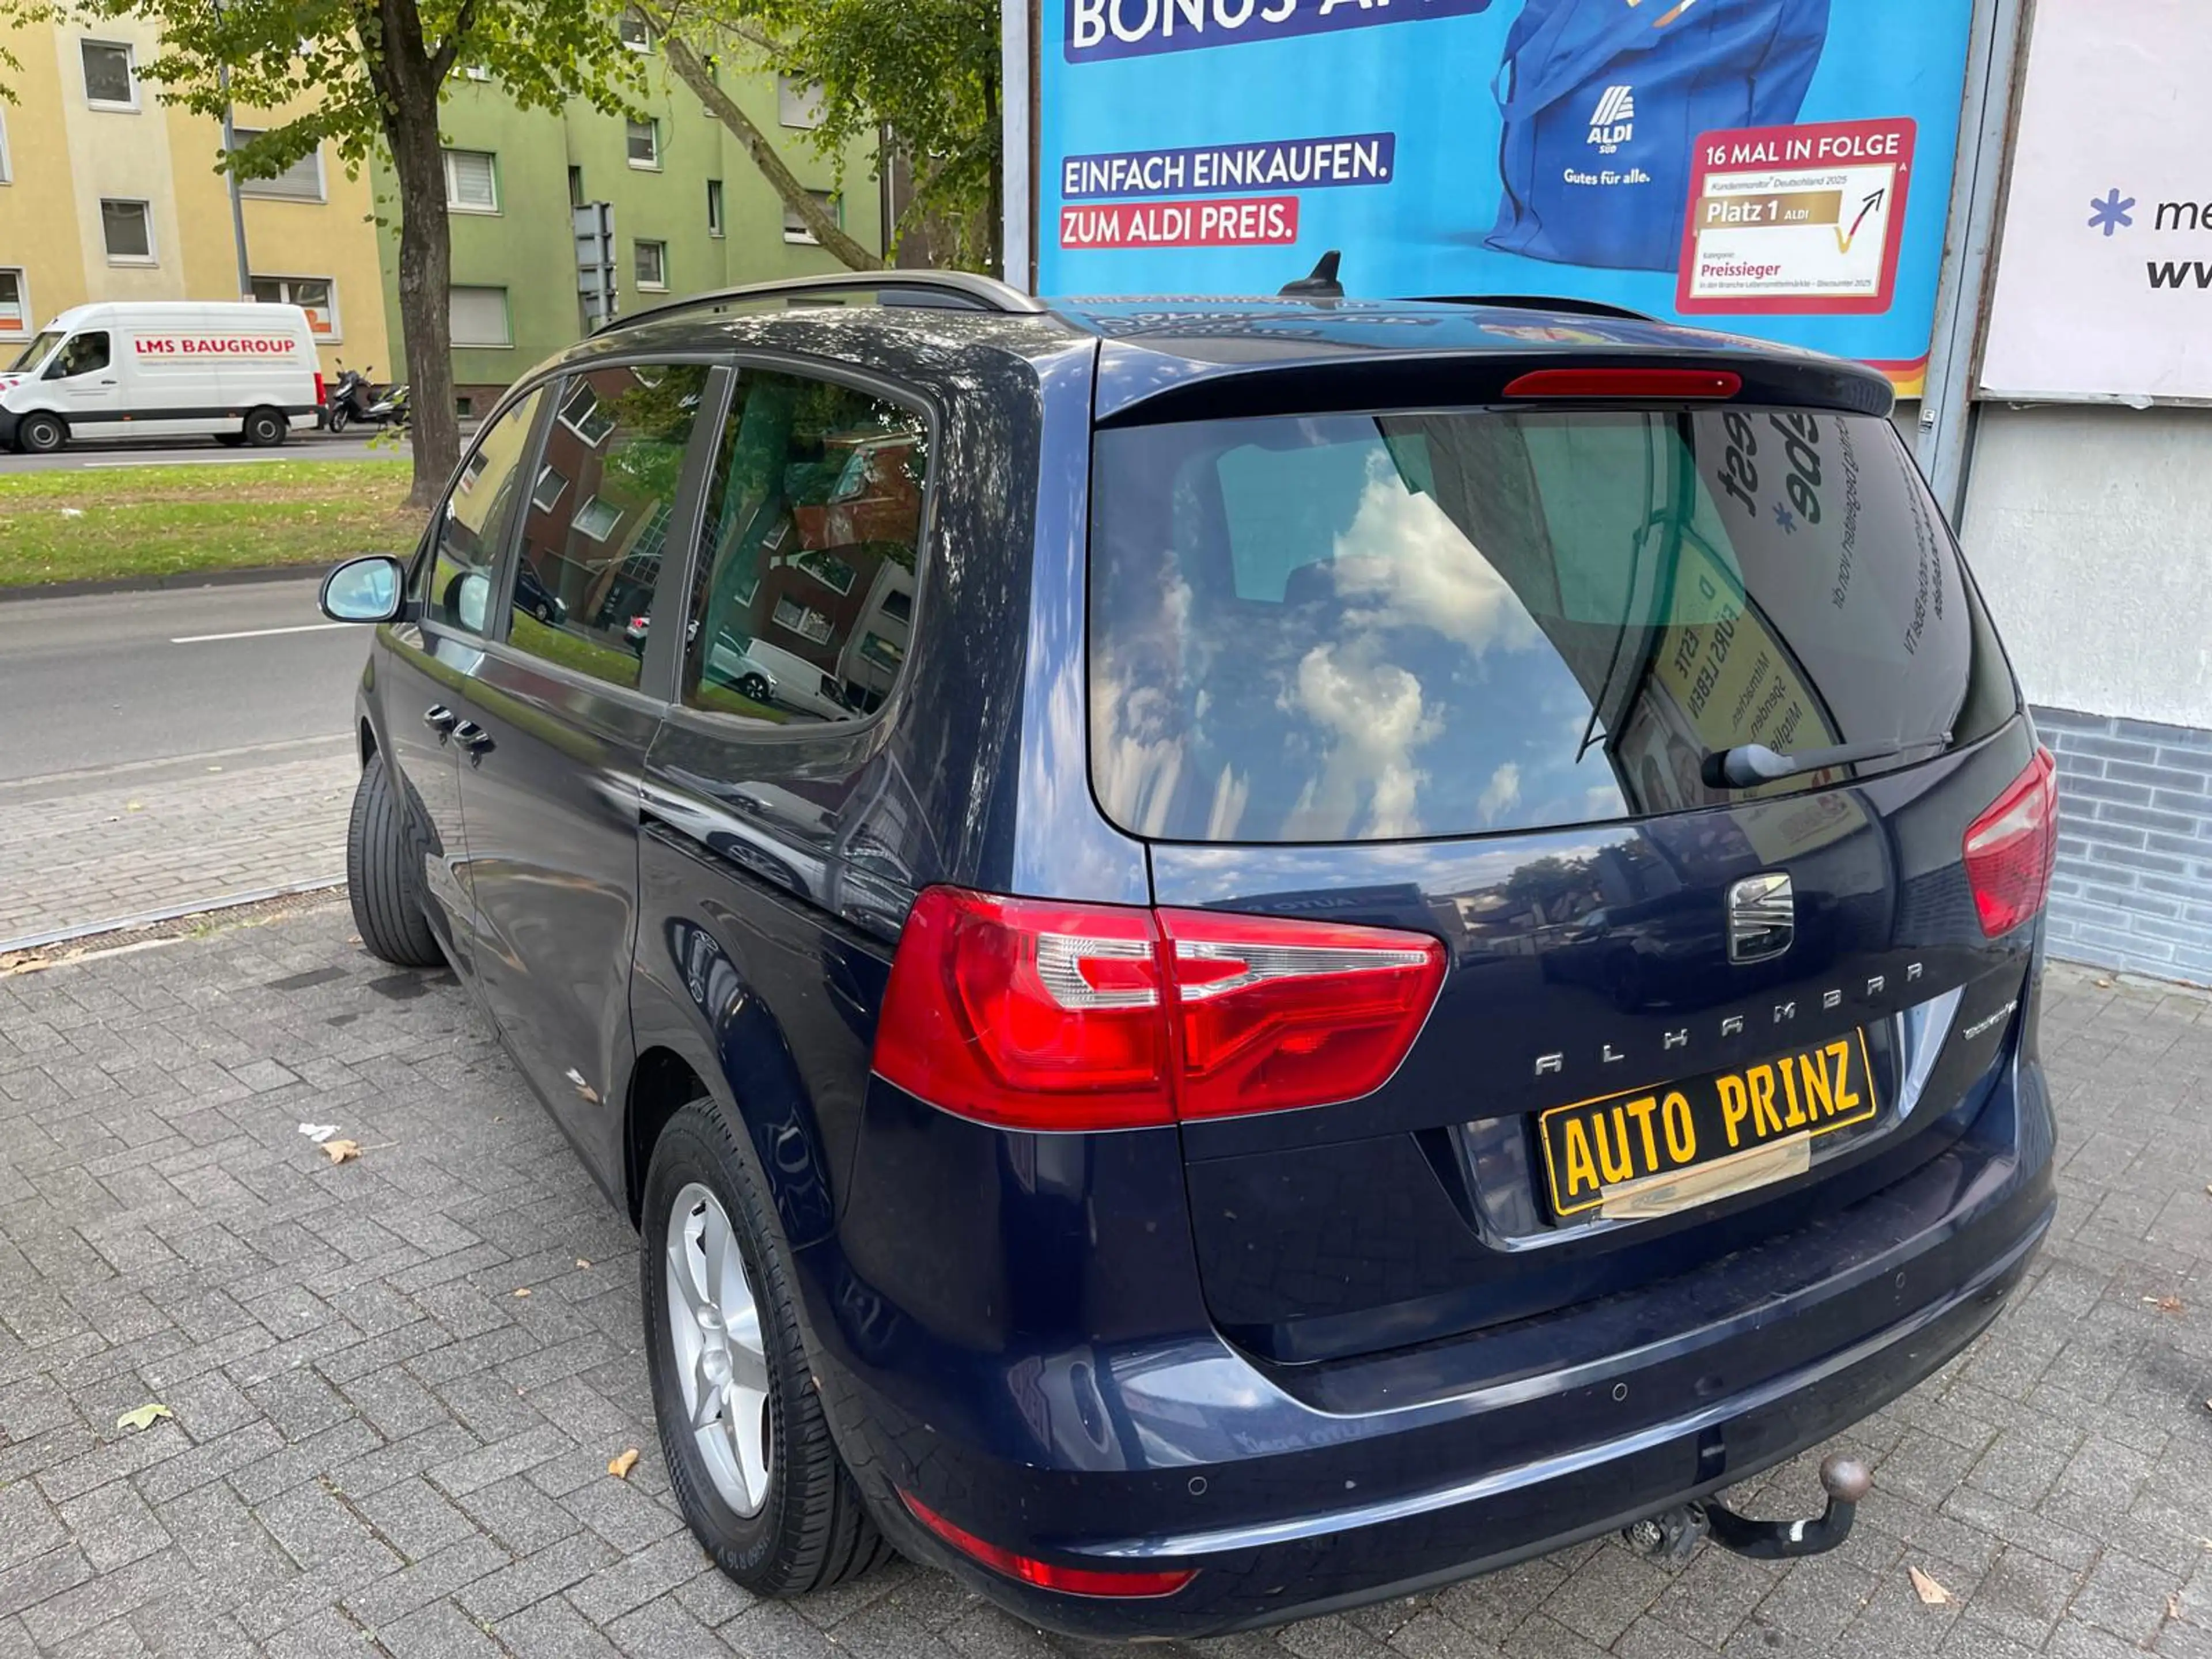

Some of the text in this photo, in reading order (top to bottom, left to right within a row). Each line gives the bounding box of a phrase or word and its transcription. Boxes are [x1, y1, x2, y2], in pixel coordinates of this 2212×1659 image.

[1586, 123, 1633, 144] ALDI
[1706, 134, 1900, 165] 16 MAL IN FOLGE
[1064, 140, 1388, 194] EINFACH EINKAUFEN.
[1563, 168, 1650, 185] Gutes für alle.
[1061, 203, 1292, 244] ZUM ALDI PREIS.
[1706, 200, 1809, 224] Platz 1 ALDI
[1701, 261, 1781, 279] Preissieger
[135, 339, 296, 354] LMS BAUGROUP
[1535, 961, 1923, 1076] ALHAMBRA
[1565, 1040, 1859, 1196] AUTO PRINZ
